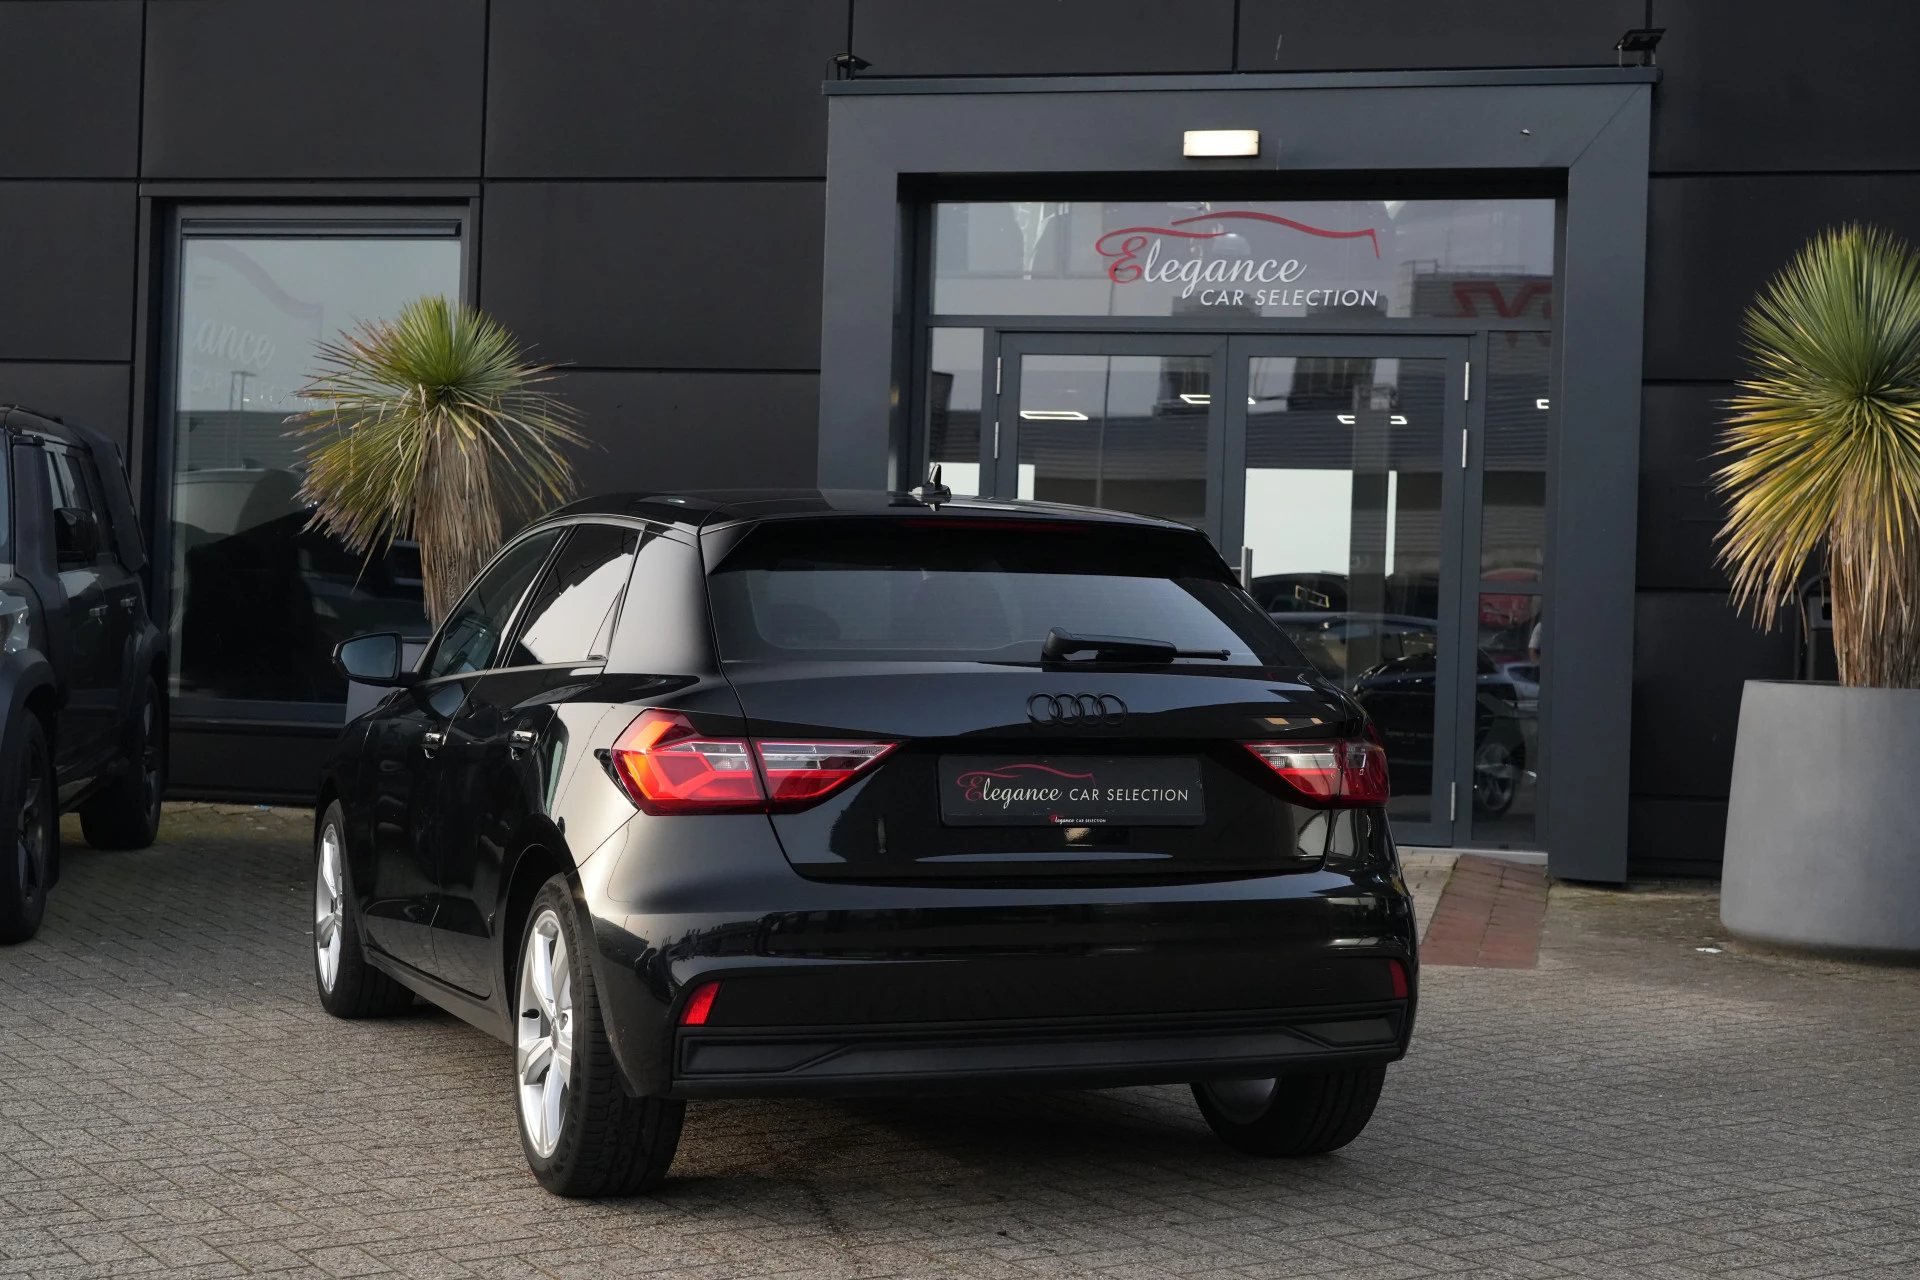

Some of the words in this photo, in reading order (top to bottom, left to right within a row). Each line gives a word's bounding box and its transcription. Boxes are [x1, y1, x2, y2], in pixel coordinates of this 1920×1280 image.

[1095, 230, 1307, 299] Elegance
[1200, 289, 1244, 306] CAR
[1254, 289, 1378, 307] SELECTION
[957, 774, 1063, 810] Elegance
[1069, 788, 1100, 802] CAR
[1106, 788, 1188, 802] SELECTION
